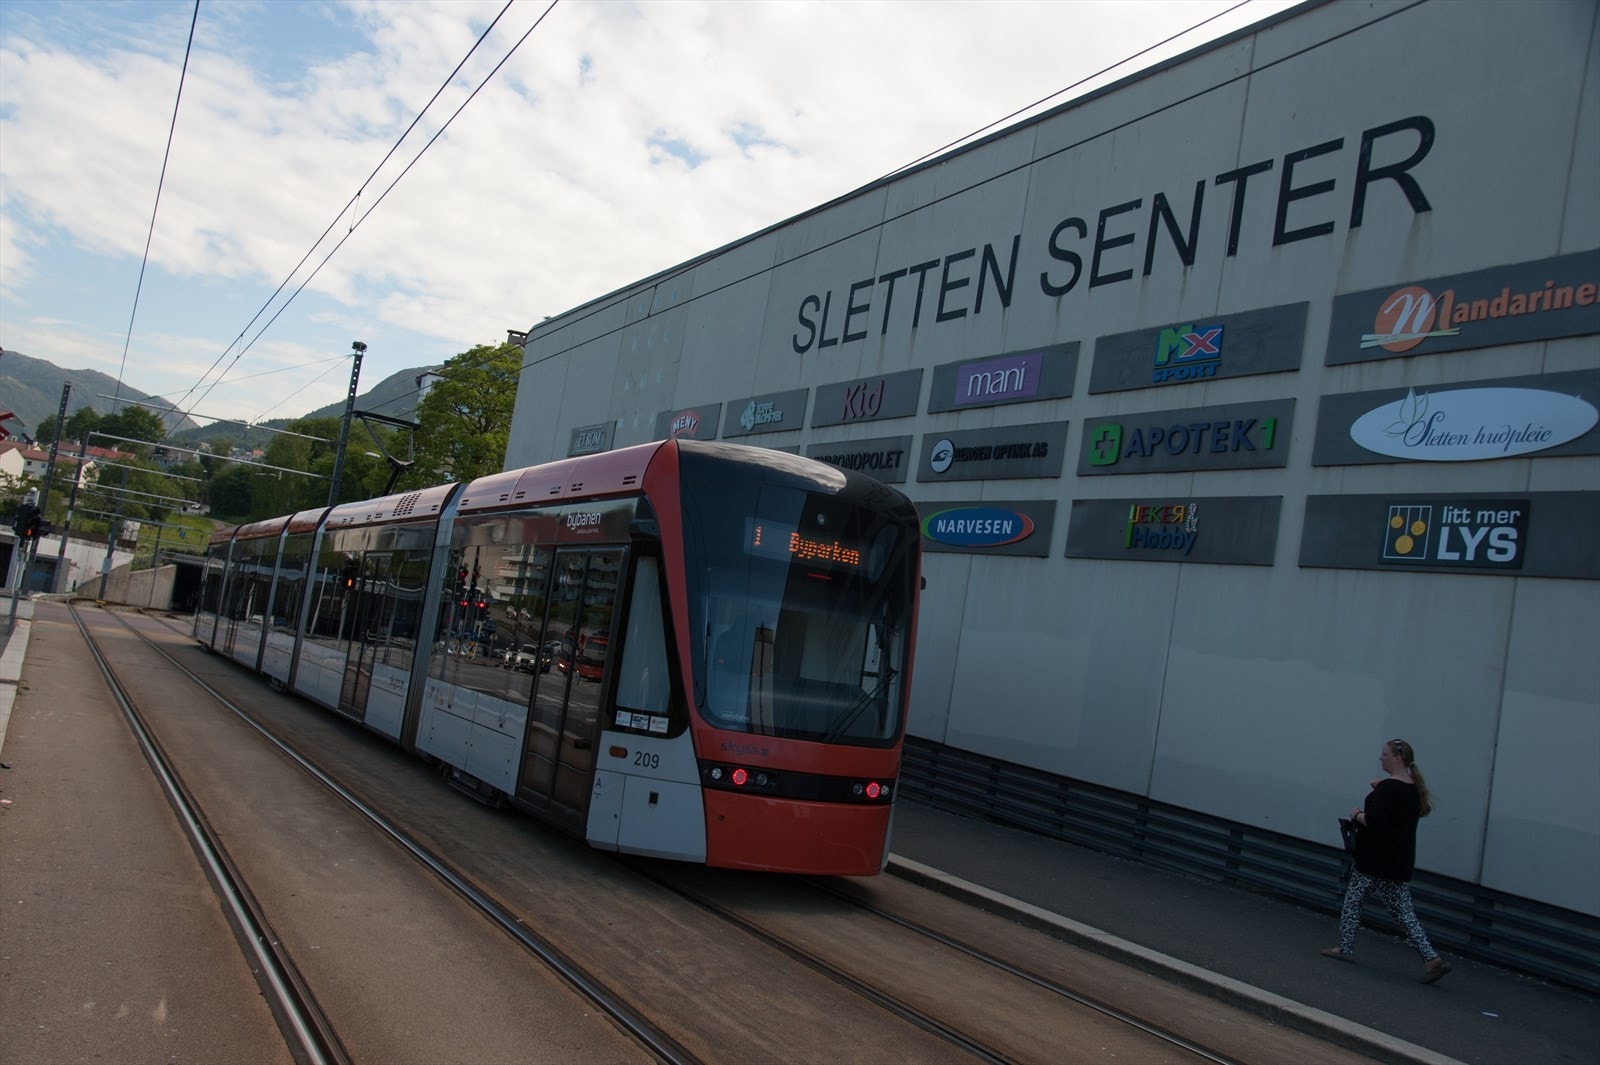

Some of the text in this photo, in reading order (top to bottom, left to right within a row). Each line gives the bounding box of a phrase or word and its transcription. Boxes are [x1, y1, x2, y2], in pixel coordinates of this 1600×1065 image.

[794, 115, 1436, 354] SLETTEN SENTER
[1384, 280, 1600, 336] Mandarine
[967, 361, 1026, 397] mani
[1153, 362, 1221, 383] SPORT
[842, 379, 885, 420] Kid
[673, 415, 698, 433] MENY
[1123, 416, 1278, 458] APOTEK 1
[1403, 411, 1553, 453] Sletten hudpleie
[992, 442, 1032, 460] OPTIKK
[1032, 442, 1048, 458] AS
[566, 511, 602, 530] bybanen
[936, 519, 1012, 534] NARVESEN
[1441, 506, 1521, 524] litt mer
[753, 525, 860, 565] 1 Byparken
[1132, 525, 1198, 557] Hobby
[1436, 526, 1519, 562] LYS
[634, 751, 659, 769] 209
[720, 740, 760, 756] skyss
